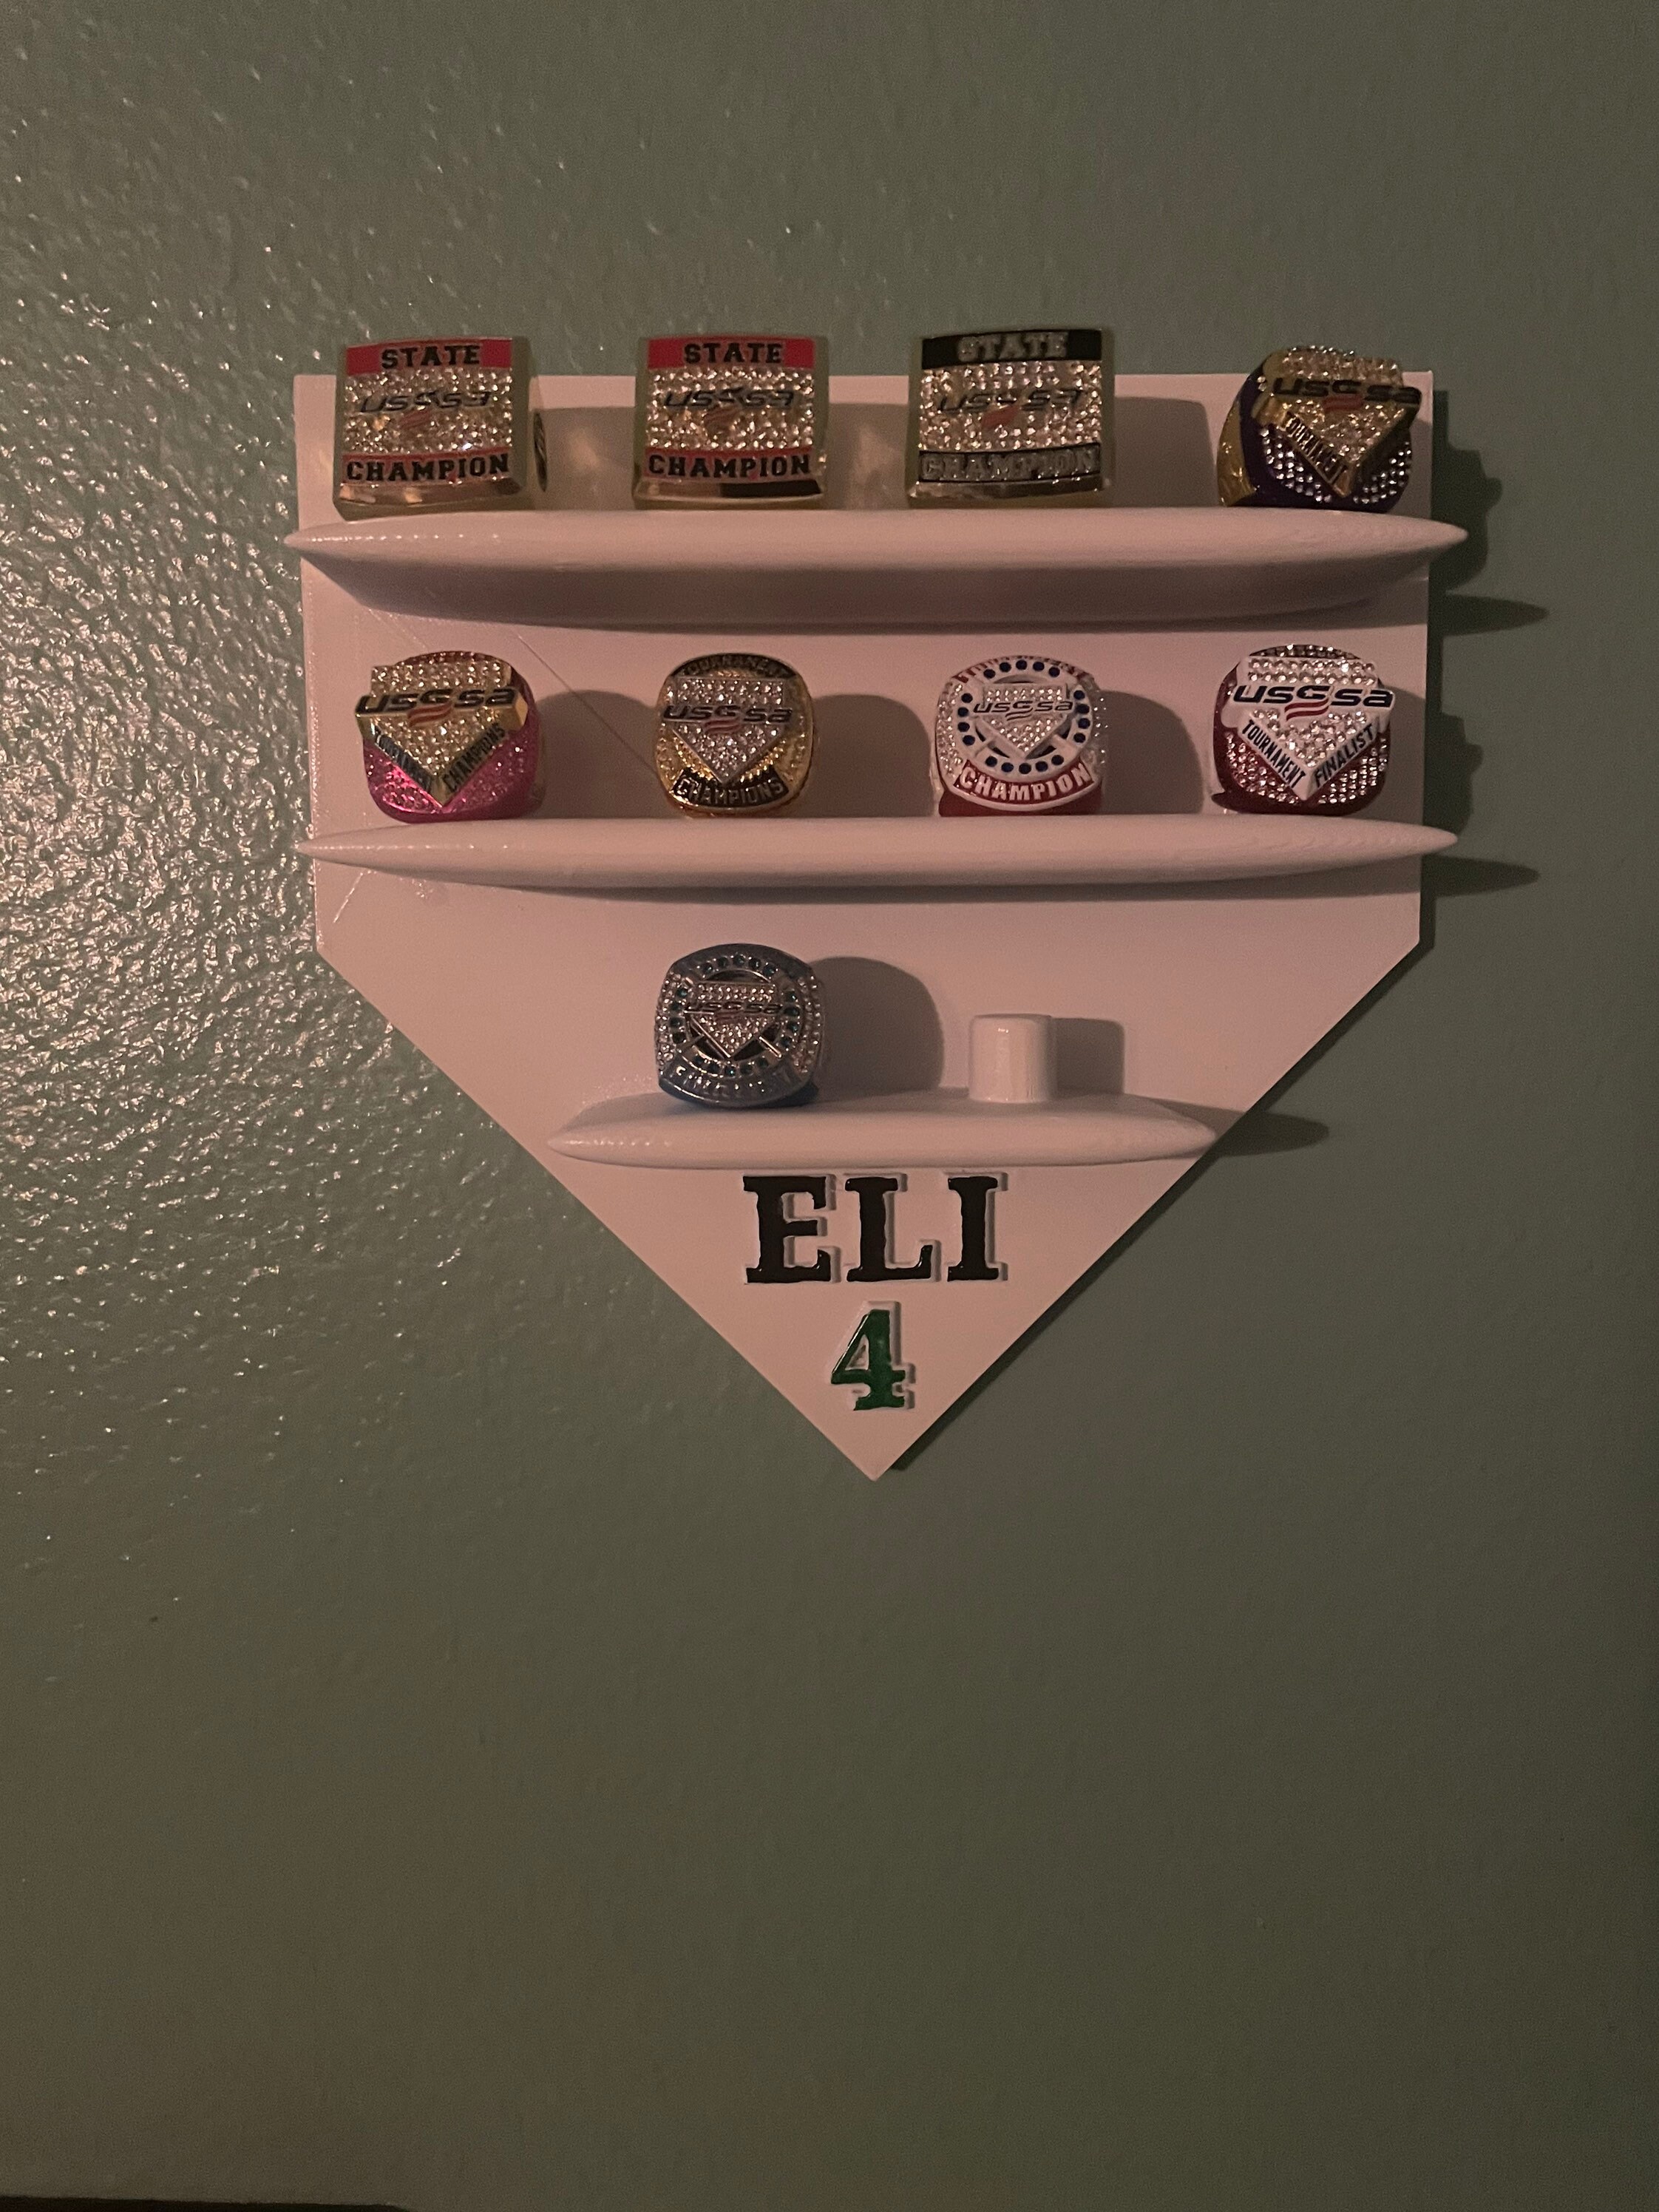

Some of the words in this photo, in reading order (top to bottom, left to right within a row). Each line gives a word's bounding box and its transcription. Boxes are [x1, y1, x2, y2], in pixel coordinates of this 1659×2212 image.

[381, 345, 481, 369] STATE
[684, 342, 784, 364] STATE
[957, 331, 1069, 362] STATE
[346, 453, 510, 481] CHAMPION
[648, 453, 812, 479] CHAMPION
[1241, 719, 1307, 789] TOURNAMENT
[1312, 722, 1375, 789] FINALIST
[961, 762, 1092, 801] CHAMPION
[742, 1173, 1004, 1284] ELI
[830, 1305, 911, 1411] 4
